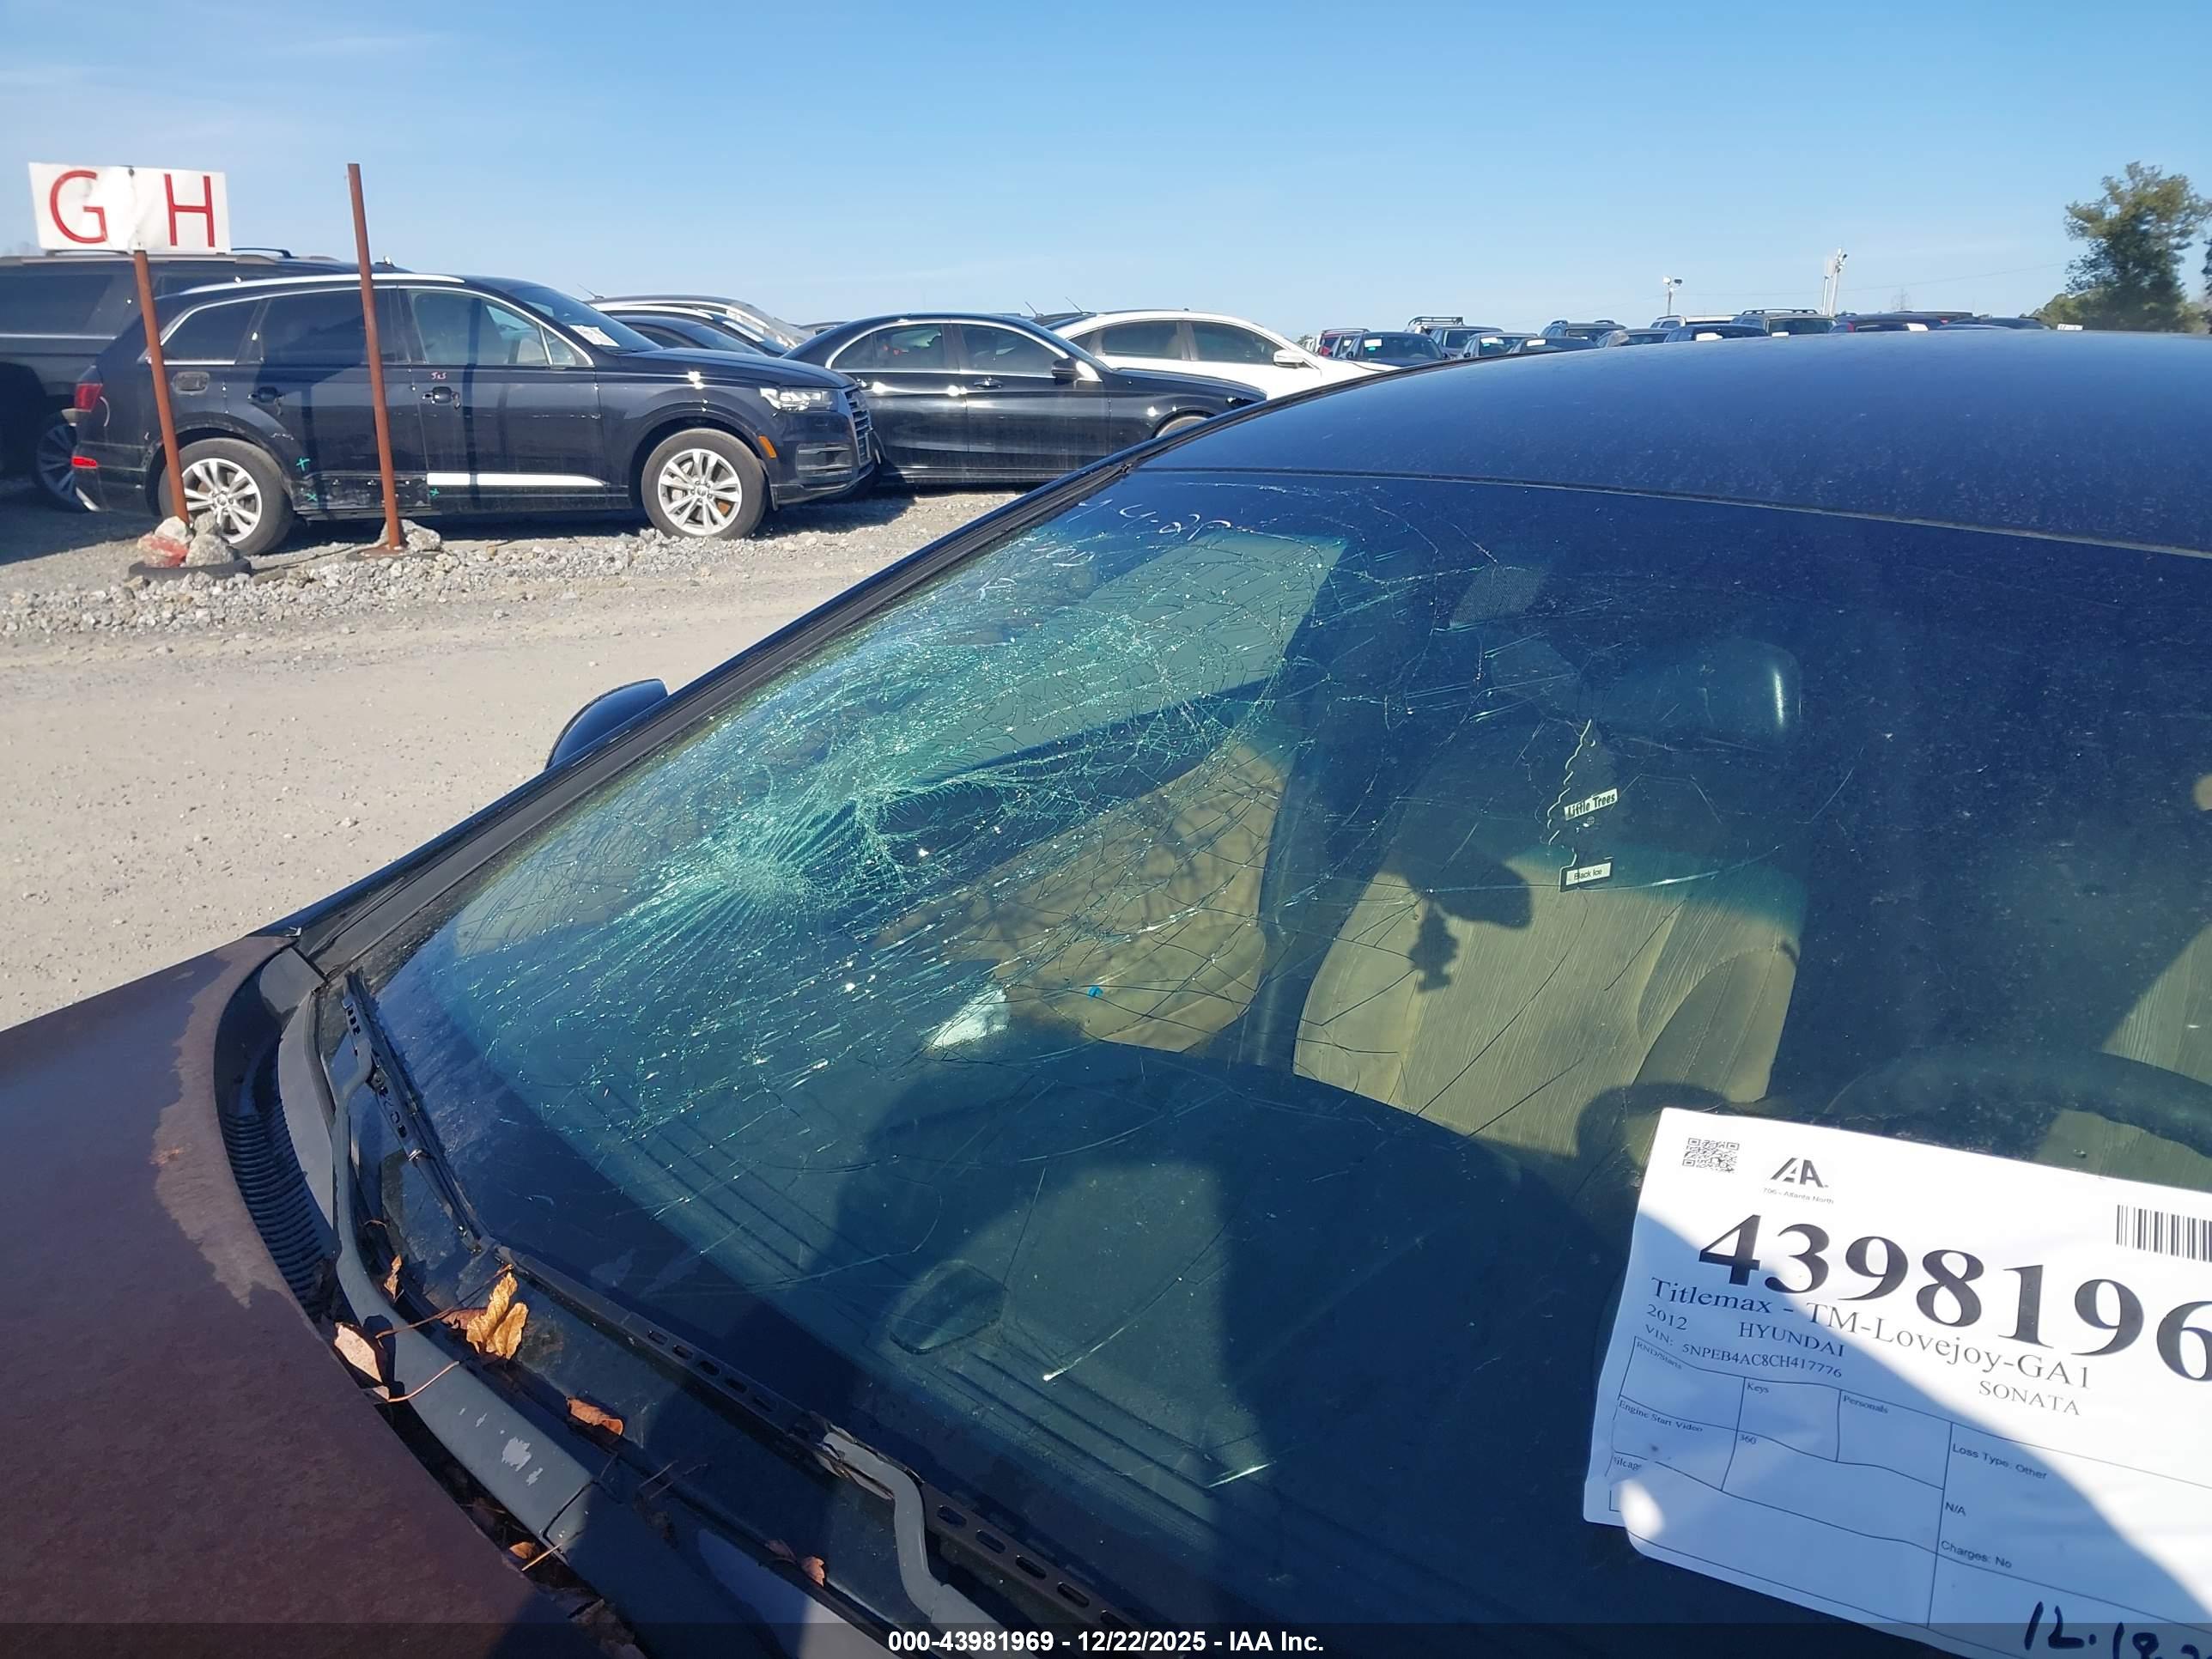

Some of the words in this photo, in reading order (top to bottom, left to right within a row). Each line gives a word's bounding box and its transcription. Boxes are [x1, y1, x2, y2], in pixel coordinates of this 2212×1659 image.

[50, 170, 108, 244] G
[164, 173, 216, 247] H
[1567, 801, 1591, 817] Little
[1592, 794, 1616, 809] Trees
[1574, 869, 1592, 880] Black
[1813, 1195, 1834, 1205] North
[1651, 1277, 1772, 1314] Titlemax
[1806, 1302, 2090, 1389] TM-Lovejoy-GA1
[1645, 1324, 1674, 1346] VIN:
[1682, 1343, 1843, 1378] 5NPEB4AC8CH417776
[1647, 1304, 1688, 1331] 2012
[1738, 1322, 1845, 1358] HYUNDAI
[1978, 1380, 2081, 1417] SONATA
[1747, 1382, 1769, 1394] Keys
[1843, 1395, 1889, 1414] Personals
[1619, 1400, 1649, 1419] Engine
[1651, 1413, 1673, 1427] Start
[1675, 1420, 1704, 1432] Video
[1740, 1434, 1758, 1445] 360
[1953, 1443, 1979, 1458] Loss
[2015, 1464, 2048, 1480] Other
[1945, 1502, 1967, 1516] N/A
[1995, 1556, 2013, 1569] No
